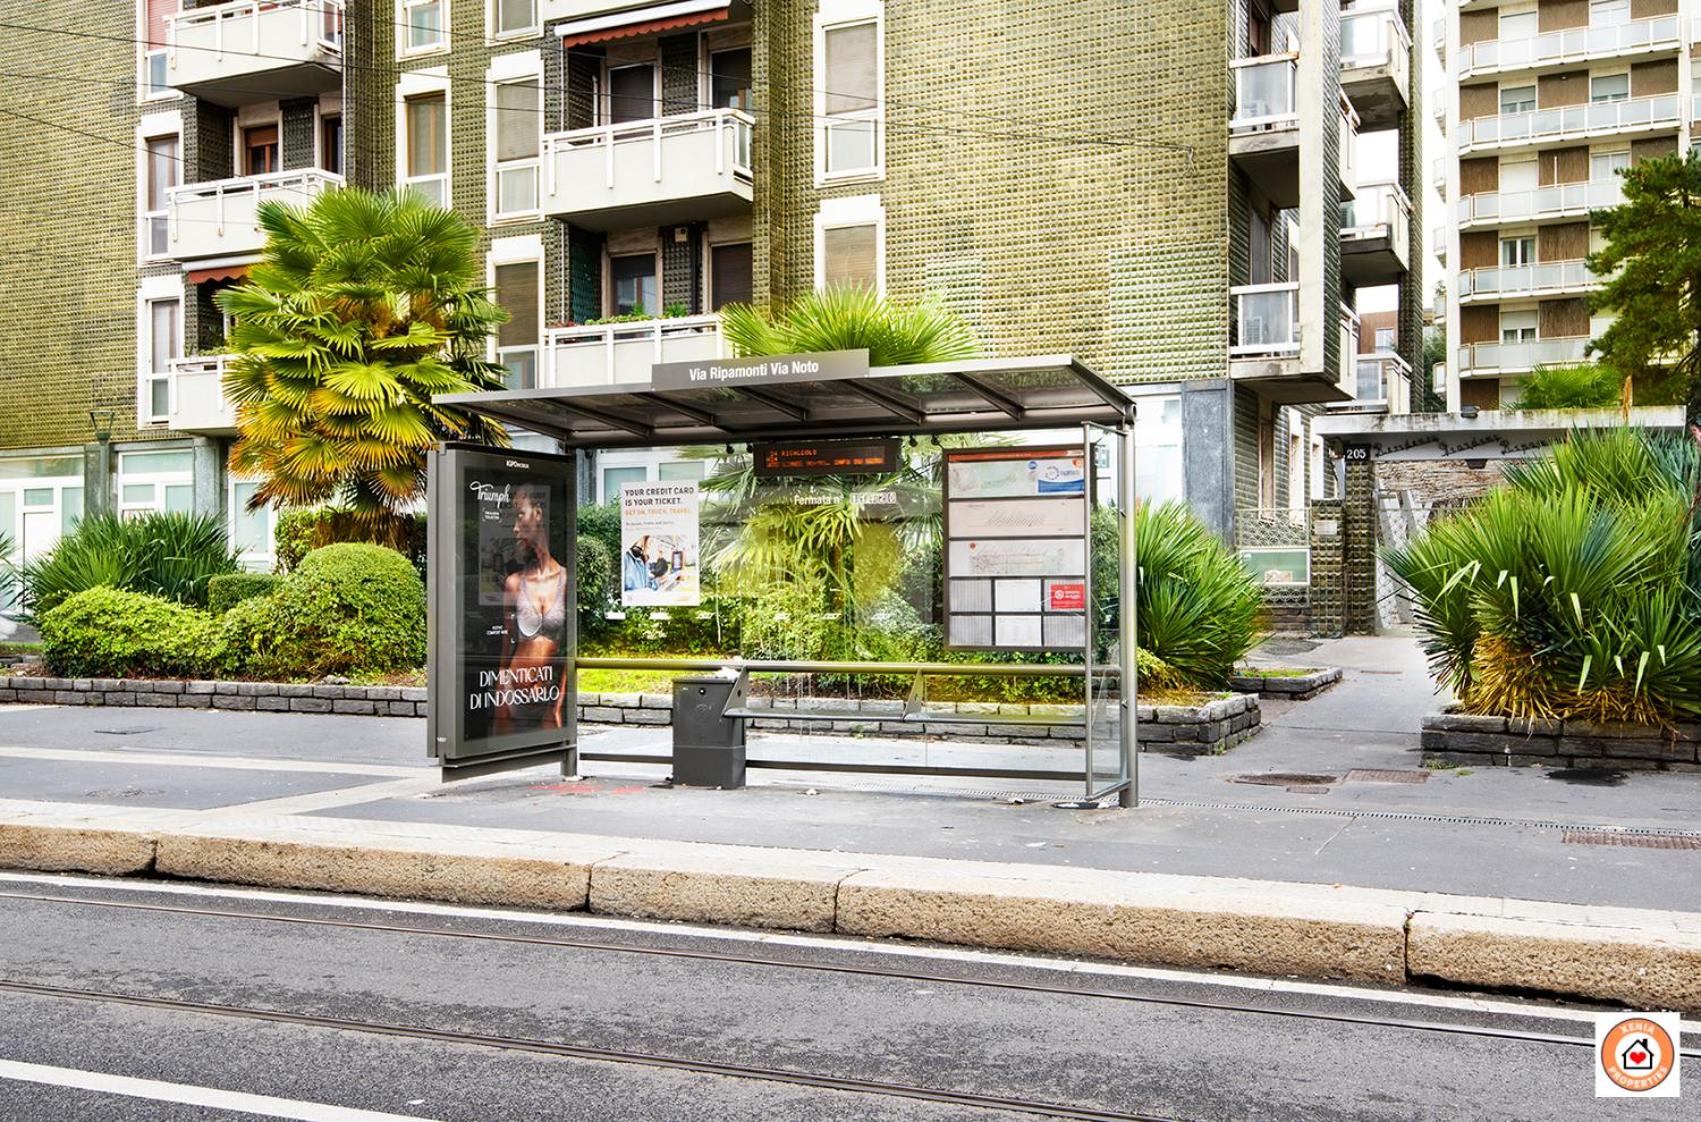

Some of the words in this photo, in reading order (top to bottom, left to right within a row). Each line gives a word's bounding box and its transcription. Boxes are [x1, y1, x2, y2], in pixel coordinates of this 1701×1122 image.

[689, 368, 707, 381] Via
[710, 363, 768, 381] Ripamonti
[770, 362, 789, 375] Via
[792, 360, 820, 375] Noto
[1346, 448, 1366, 459] 205
[469, 480, 510, 508] Triumph
[625, 488, 645, 497] YOUR
[646, 487, 673, 496] CREDIT
[674, 486, 695, 495] CARD
[794, 494, 831, 505] Fermata
[625, 499, 633, 507] IS
[634, 498, 654, 506] YOUR
[480, 666, 552, 687] DIMENTICATI
[470, 693, 481, 709] DI
[485, 685, 560, 707] INDOSSARLO
